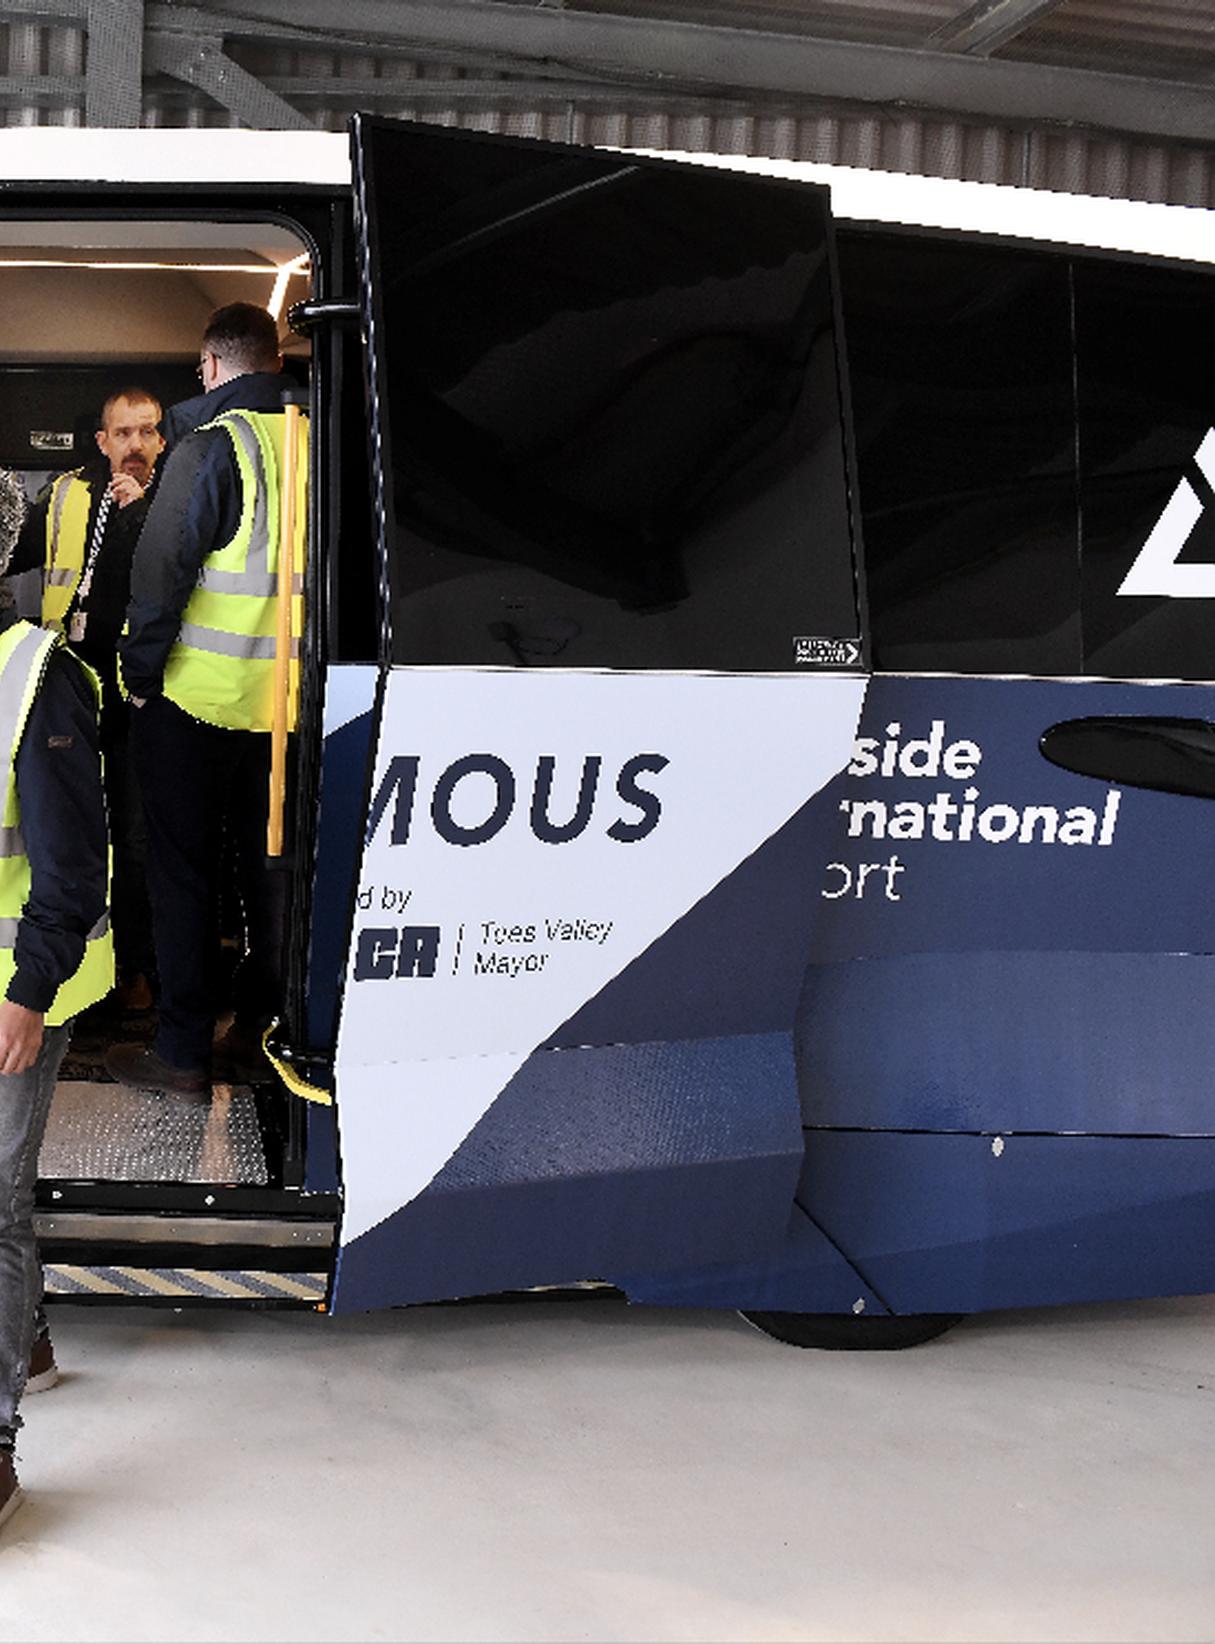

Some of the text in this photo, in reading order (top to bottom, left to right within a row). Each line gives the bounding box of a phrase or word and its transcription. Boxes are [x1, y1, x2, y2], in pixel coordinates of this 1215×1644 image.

[847, 720, 982, 779] side
[839, 786, 1121, 845] national
[381, 886, 413, 914] by
[544, 918, 614, 945] Valley
[473, 952, 550, 978] Mayor
